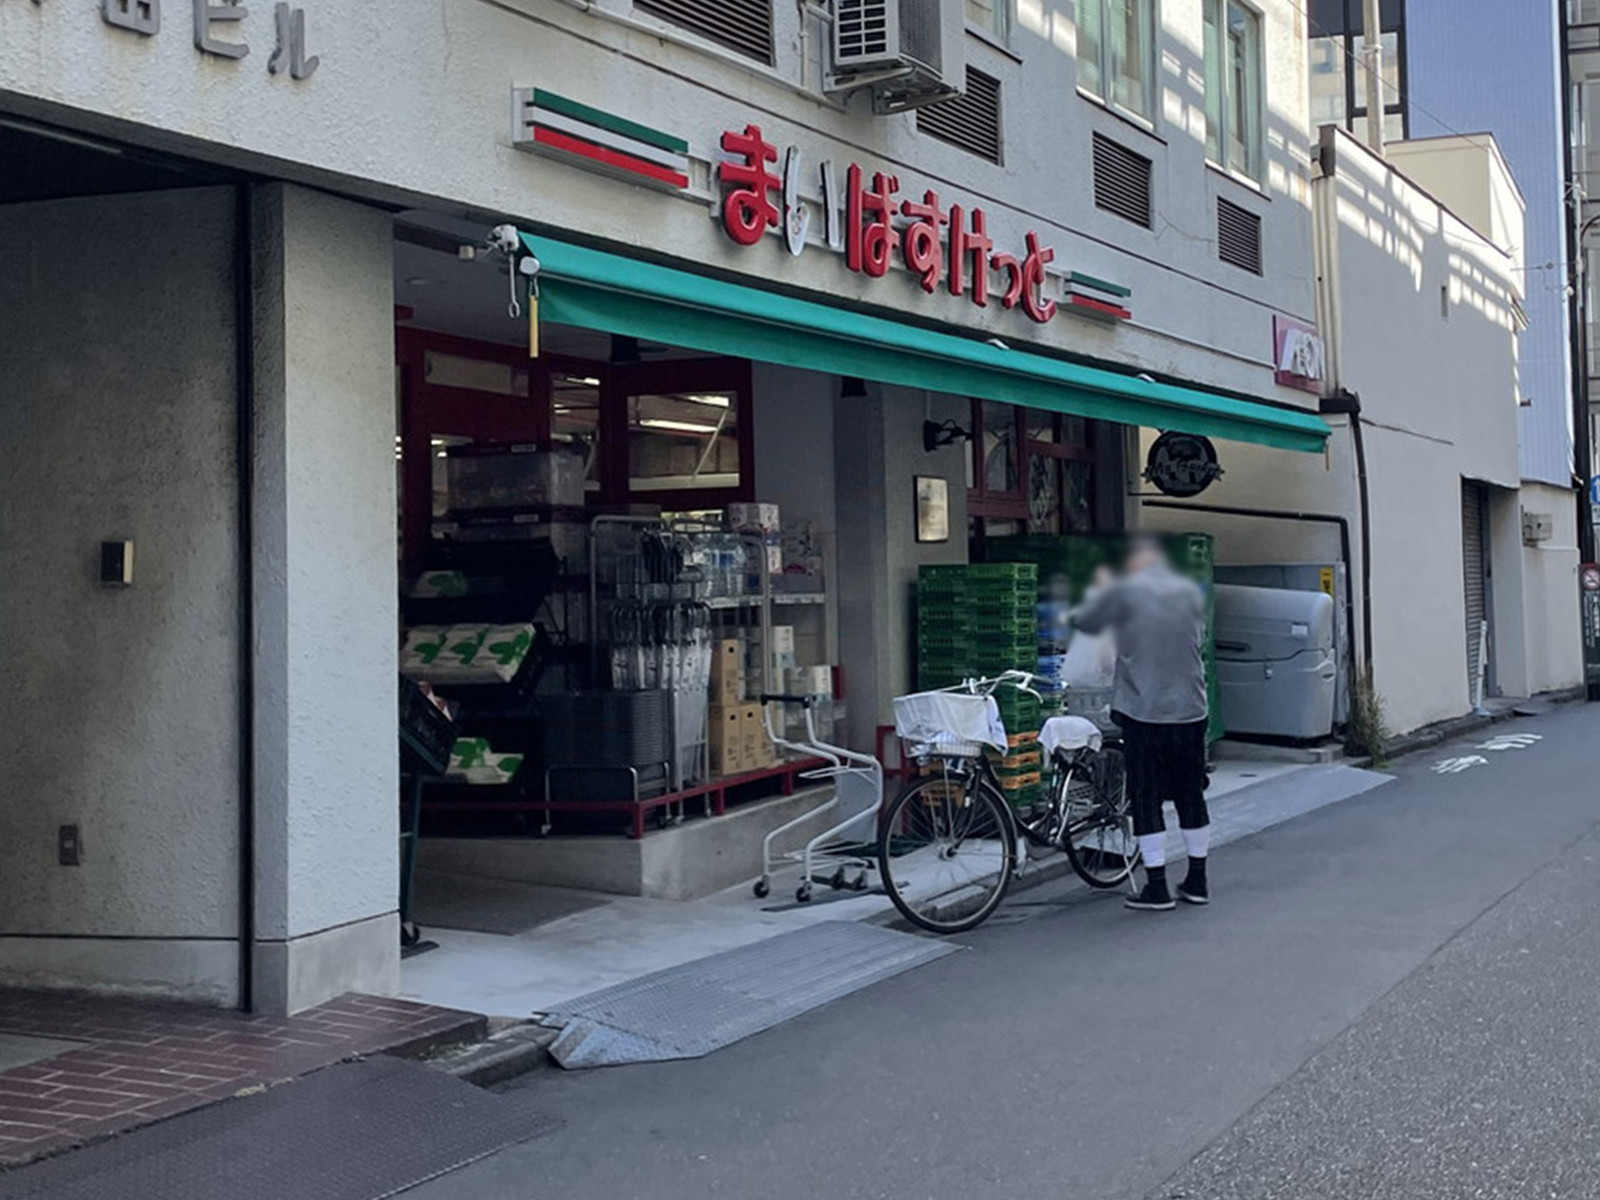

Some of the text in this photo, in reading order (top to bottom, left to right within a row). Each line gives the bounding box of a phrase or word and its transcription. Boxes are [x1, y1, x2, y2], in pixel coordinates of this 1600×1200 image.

[719, 124, 1057, 324] まいばすけっと
